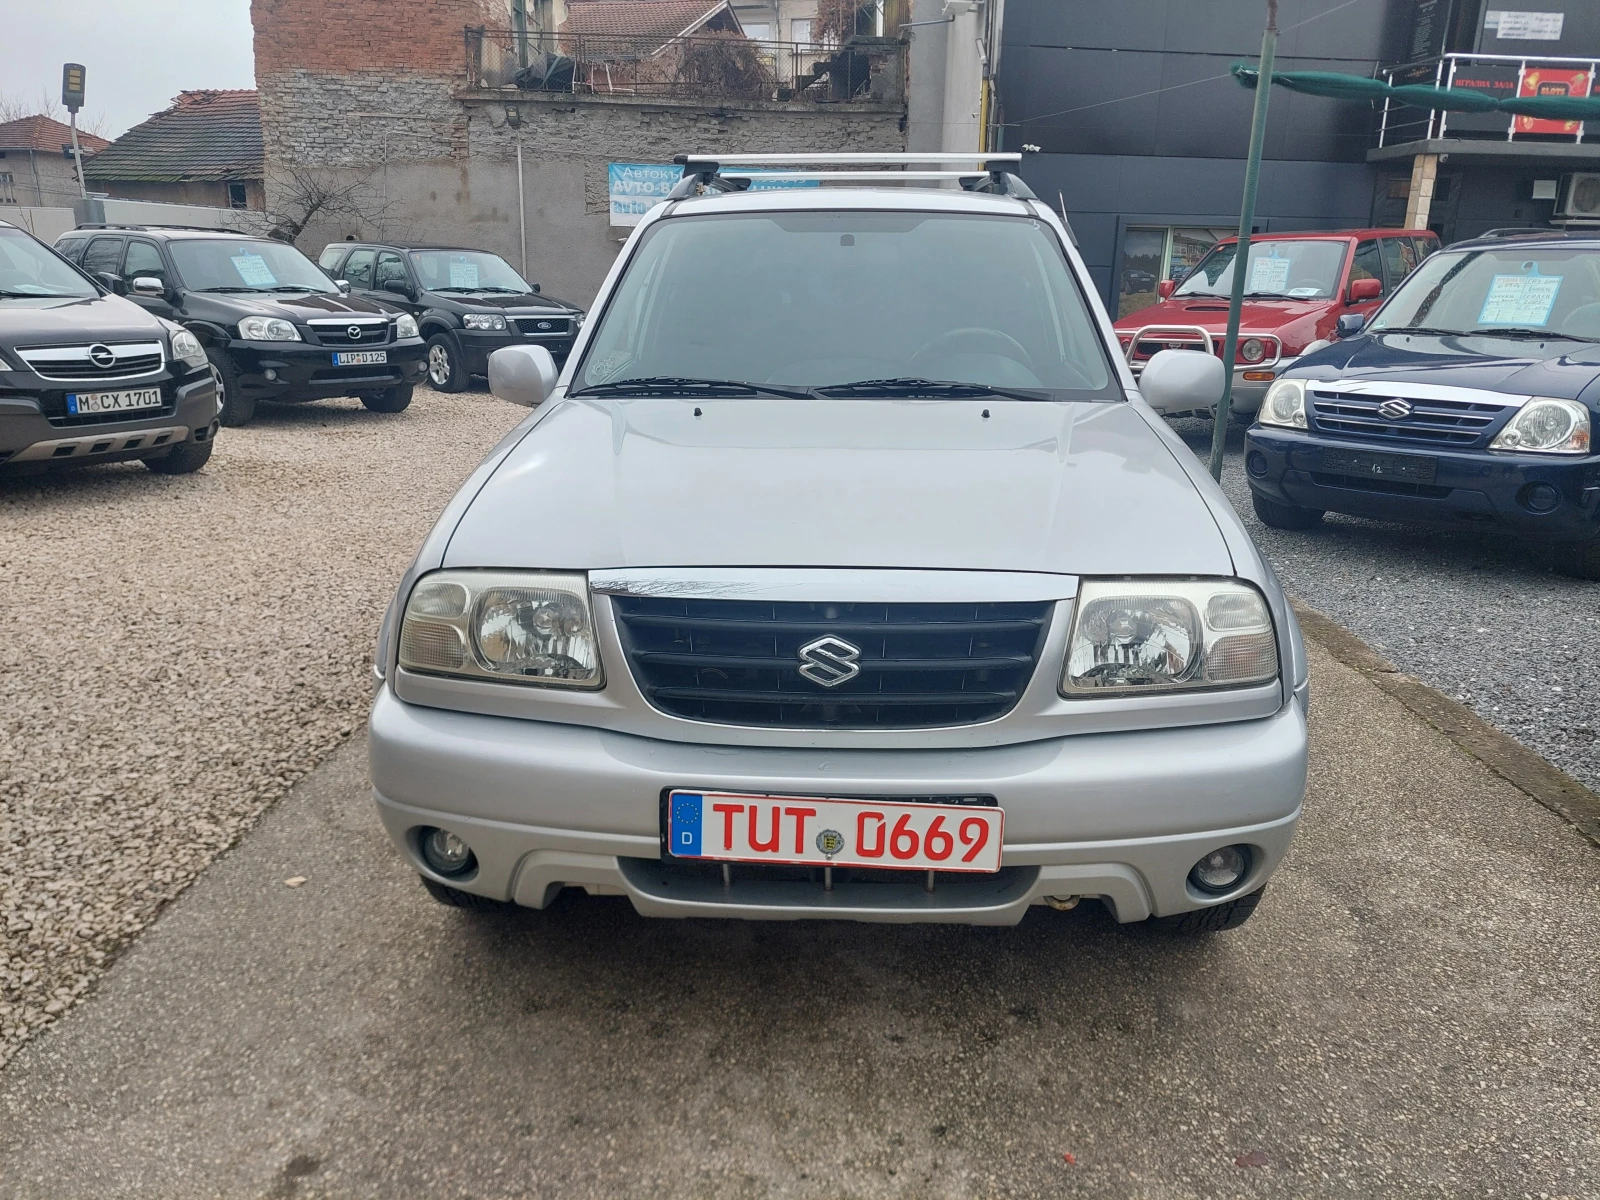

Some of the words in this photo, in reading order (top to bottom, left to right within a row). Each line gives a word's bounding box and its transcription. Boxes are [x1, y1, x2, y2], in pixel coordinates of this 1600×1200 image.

[339, 353, 356, 364] LIP
[362, 353, 368, 363] D
[369, 352, 386, 363] 125
[78, 396, 91, 411] M
[100, 393, 122, 409] CX
[125, 390, 160, 407] 1701
[1371, 463, 1383, 474] 12
[681, 831, 693, 845] D
[712, 803, 817, 854] TUT
[855, 811, 989, 863] 0669
